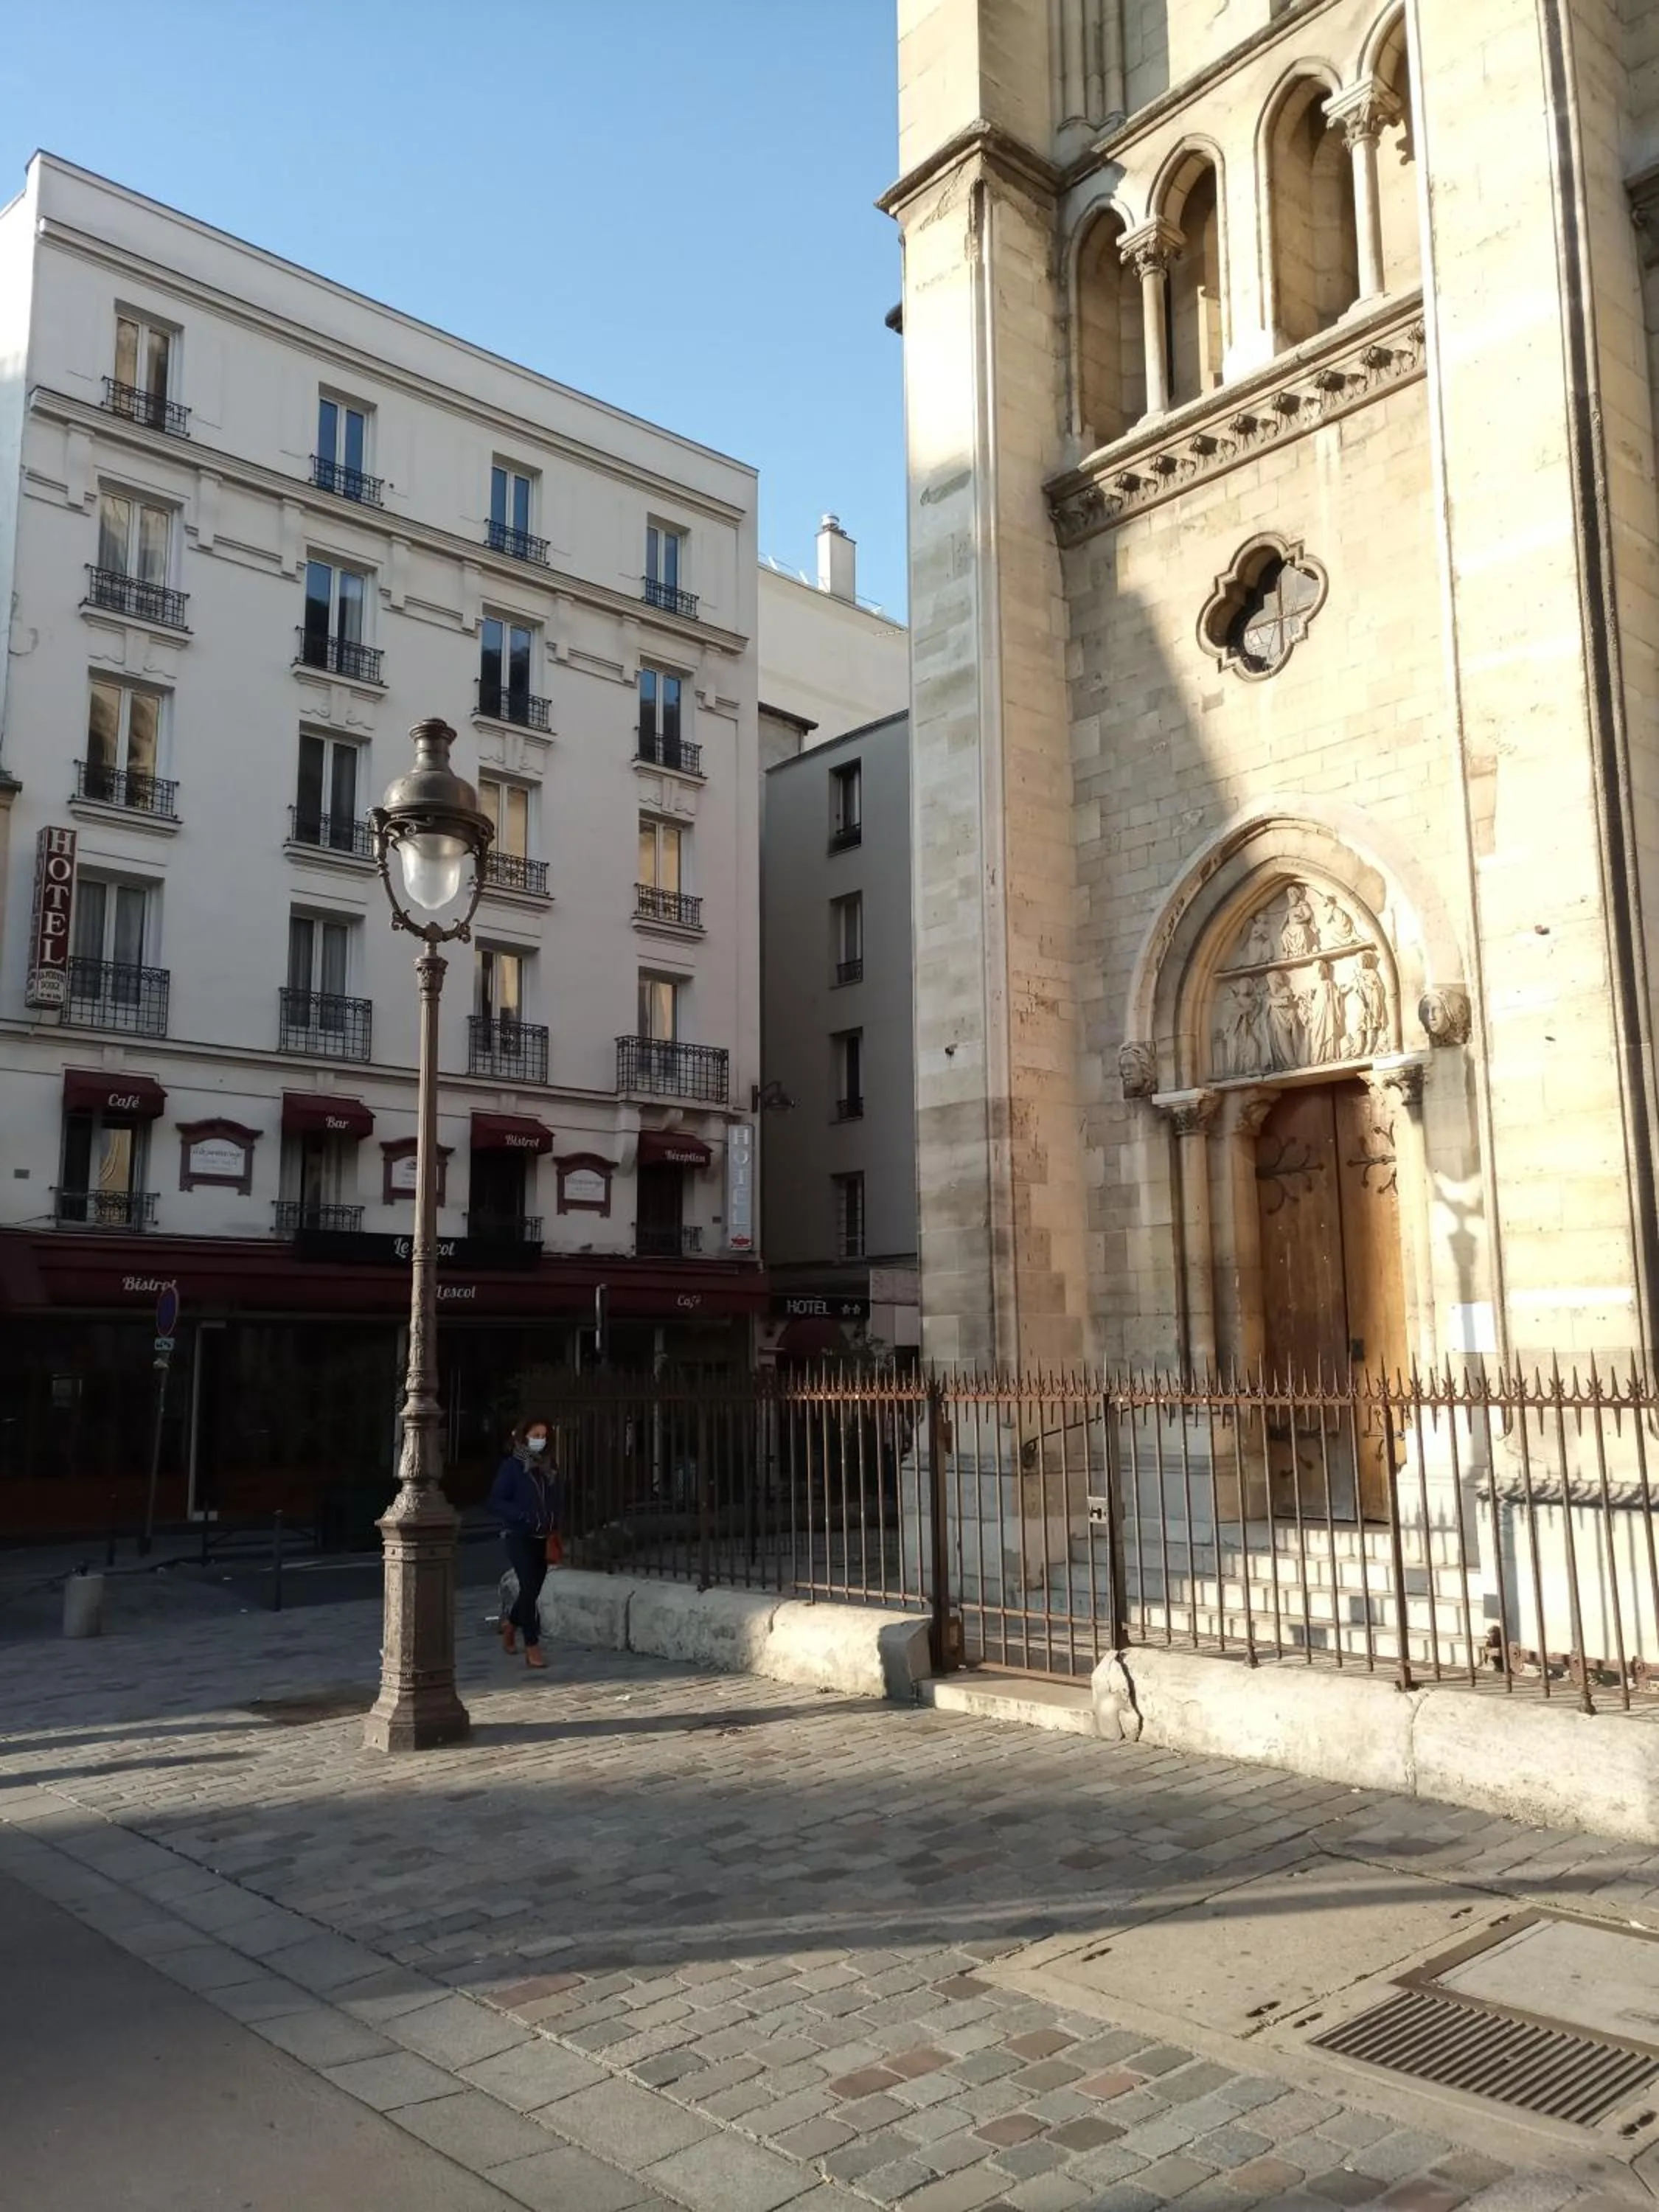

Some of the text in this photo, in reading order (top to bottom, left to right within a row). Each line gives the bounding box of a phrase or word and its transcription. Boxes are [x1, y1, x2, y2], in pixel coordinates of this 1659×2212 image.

[41, 829, 74, 964] HOTEL
[108, 1093, 140, 1109] Café
[325, 1116, 349, 1129] Bar
[731, 1128, 749, 1225] HOTEL
[394, 1237, 409, 1258] Le
[786, 1300, 832, 1315] HOTEL
